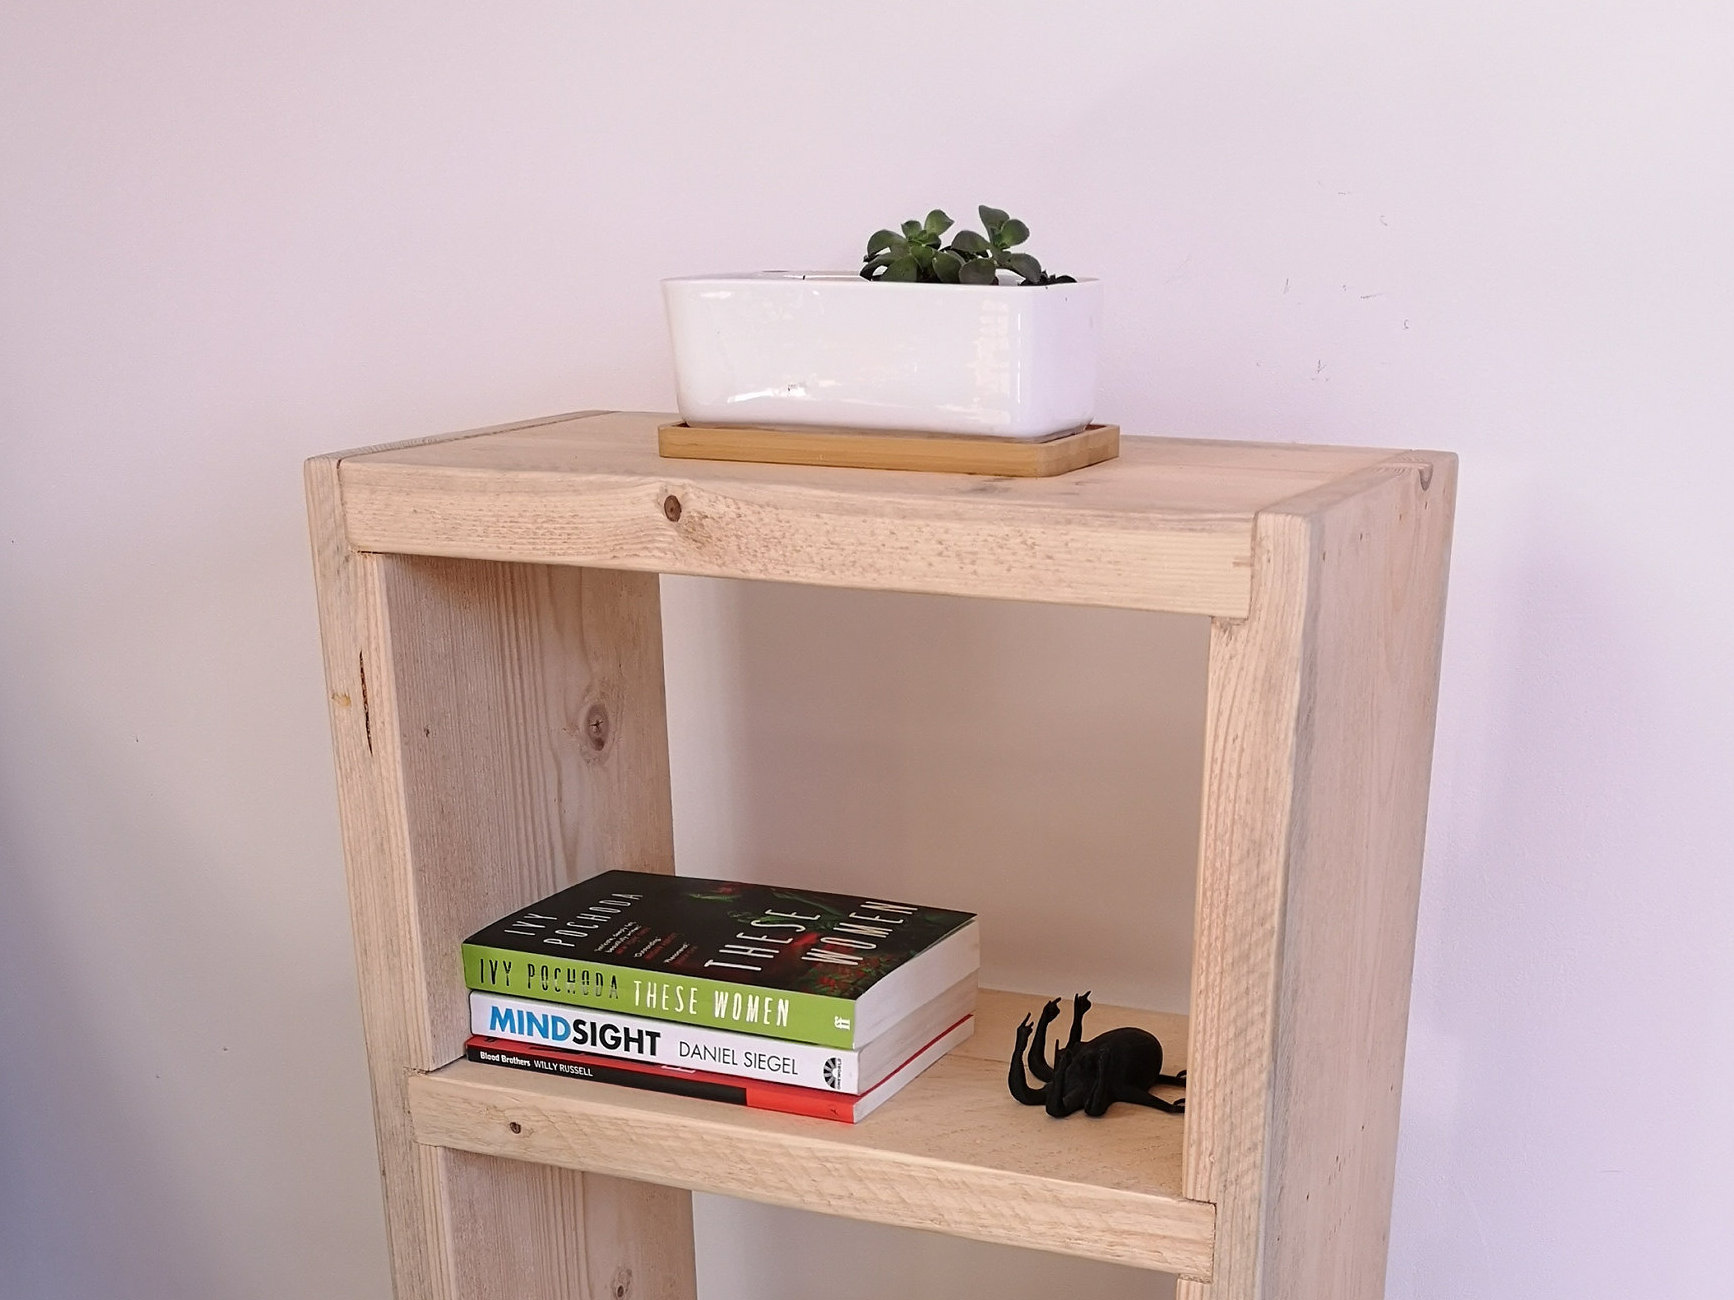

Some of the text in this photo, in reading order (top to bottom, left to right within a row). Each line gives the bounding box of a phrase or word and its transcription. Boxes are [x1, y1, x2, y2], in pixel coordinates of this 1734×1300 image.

[504, 913, 557, 935] IVY
[543, 893, 643, 947] POCHODA
[704, 909, 821, 971] THESE
[802, 901, 918, 965] WOMEN
[480, 958, 790, 1027] IVY POCHODA THESE WOMEN
[480, 1051, 593, 1077] Blood Brothers WILLY RUSSELL
[489, 1005, 798, 1075] MINDSIGHT DANIEL SIEGEL
